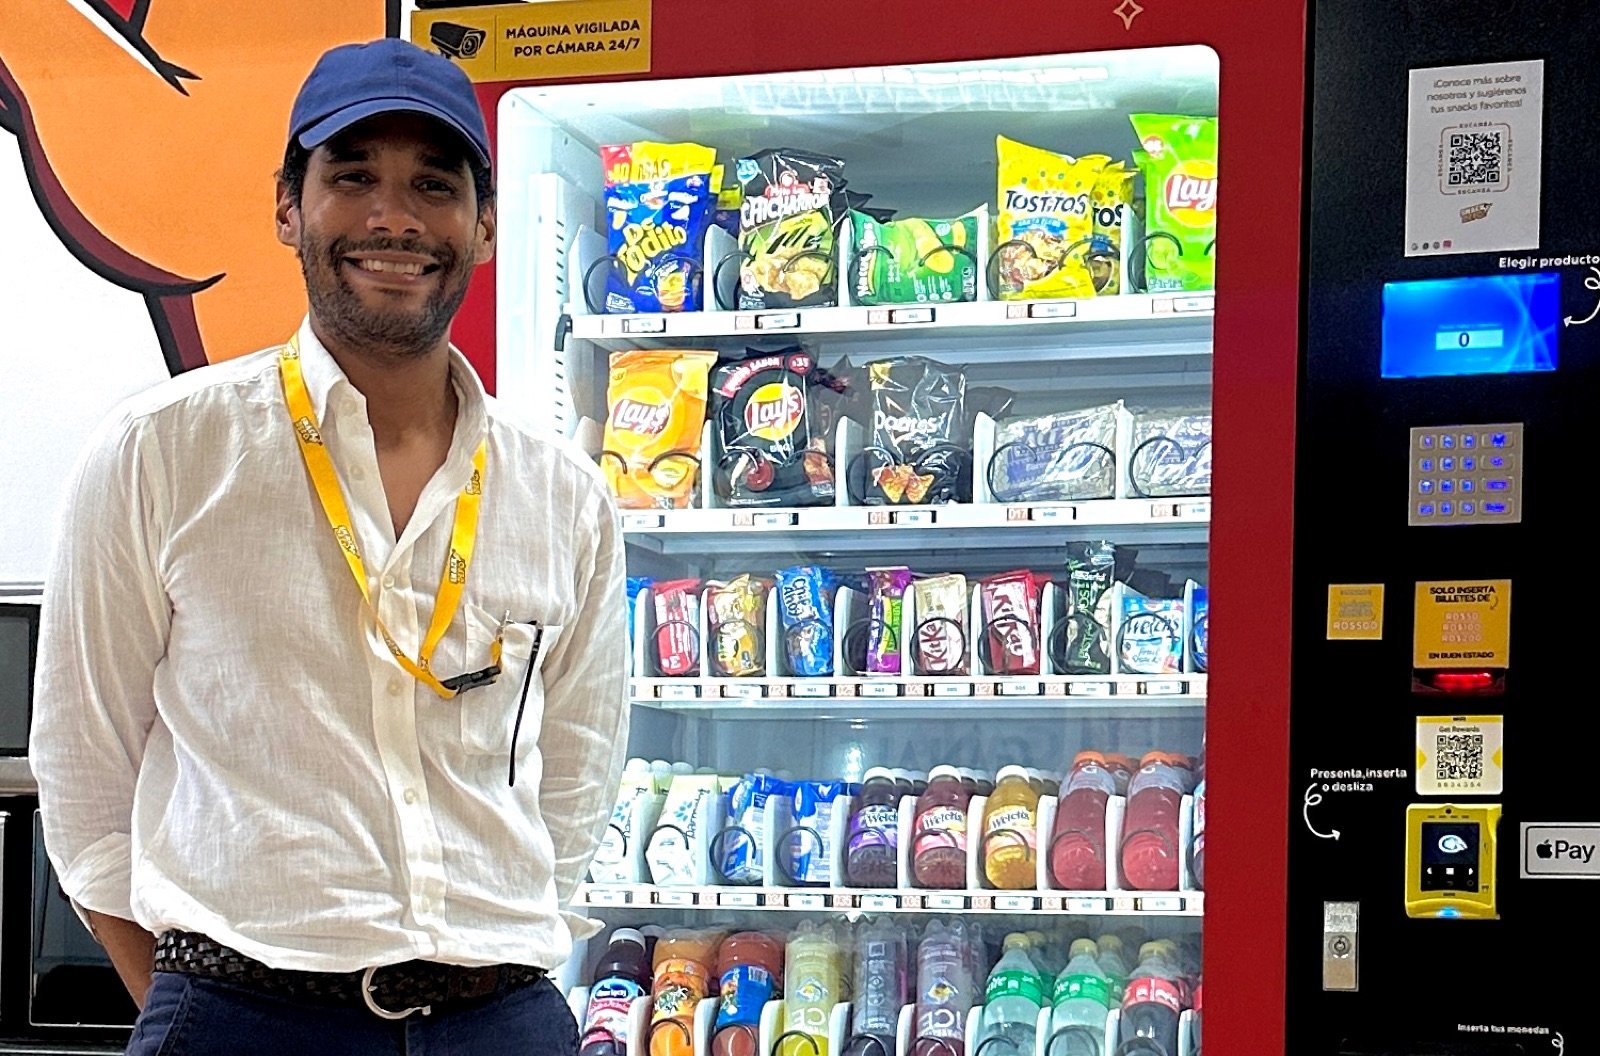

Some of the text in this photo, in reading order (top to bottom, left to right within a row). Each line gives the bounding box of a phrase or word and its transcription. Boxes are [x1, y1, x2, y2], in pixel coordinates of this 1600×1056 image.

[506, 20, 640, 39] MÁQUINA VIGILADA
[514, 38, 640, 57] POR CÁMARA 24/7
[1495, 75, 1521, 83] sobre
[1427, 92, 1466, 100] nosotros
[1447, 102, 1477, 112] snacks
[1499, 255, 1600, 269] Elegir producto
[1459, 332, 1470, 347] 0
[1478, 594, 1490, 602] DE
[1463, 651, 1494, 659] ESTADO
[1322, 782, 1373, 792] o desliza
[1555, 840, 1595, 864] Pay
